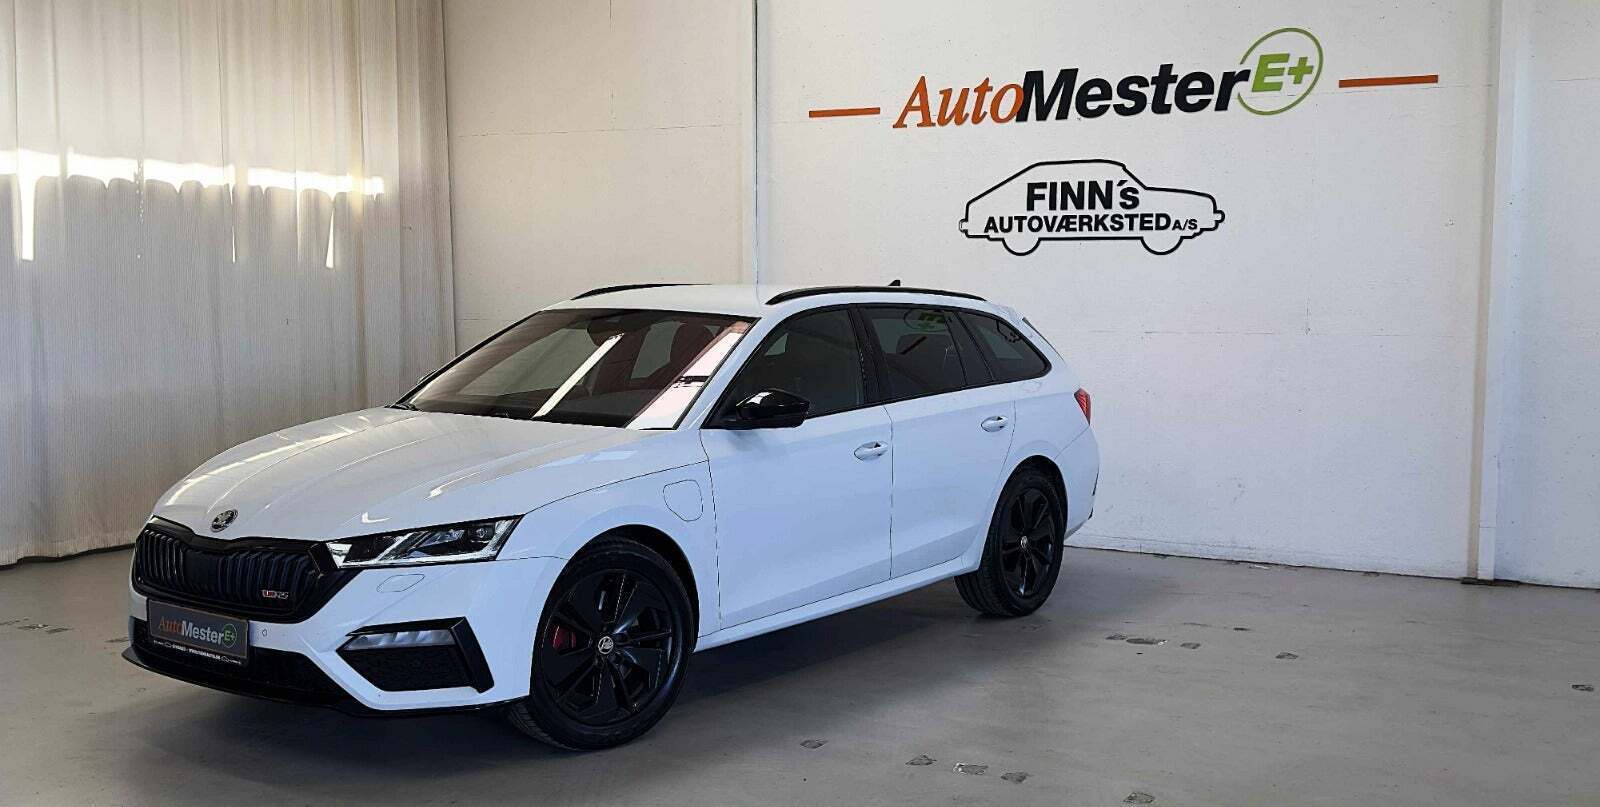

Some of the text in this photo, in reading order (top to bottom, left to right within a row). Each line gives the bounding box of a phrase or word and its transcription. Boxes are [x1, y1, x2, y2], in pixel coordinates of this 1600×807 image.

[893, 53, 1314, 128] AutoMester E+
[983, 213, 1198, 234] AUTOVÆRKSTED A/S
[158, 617, 224, 645] AutoMester
